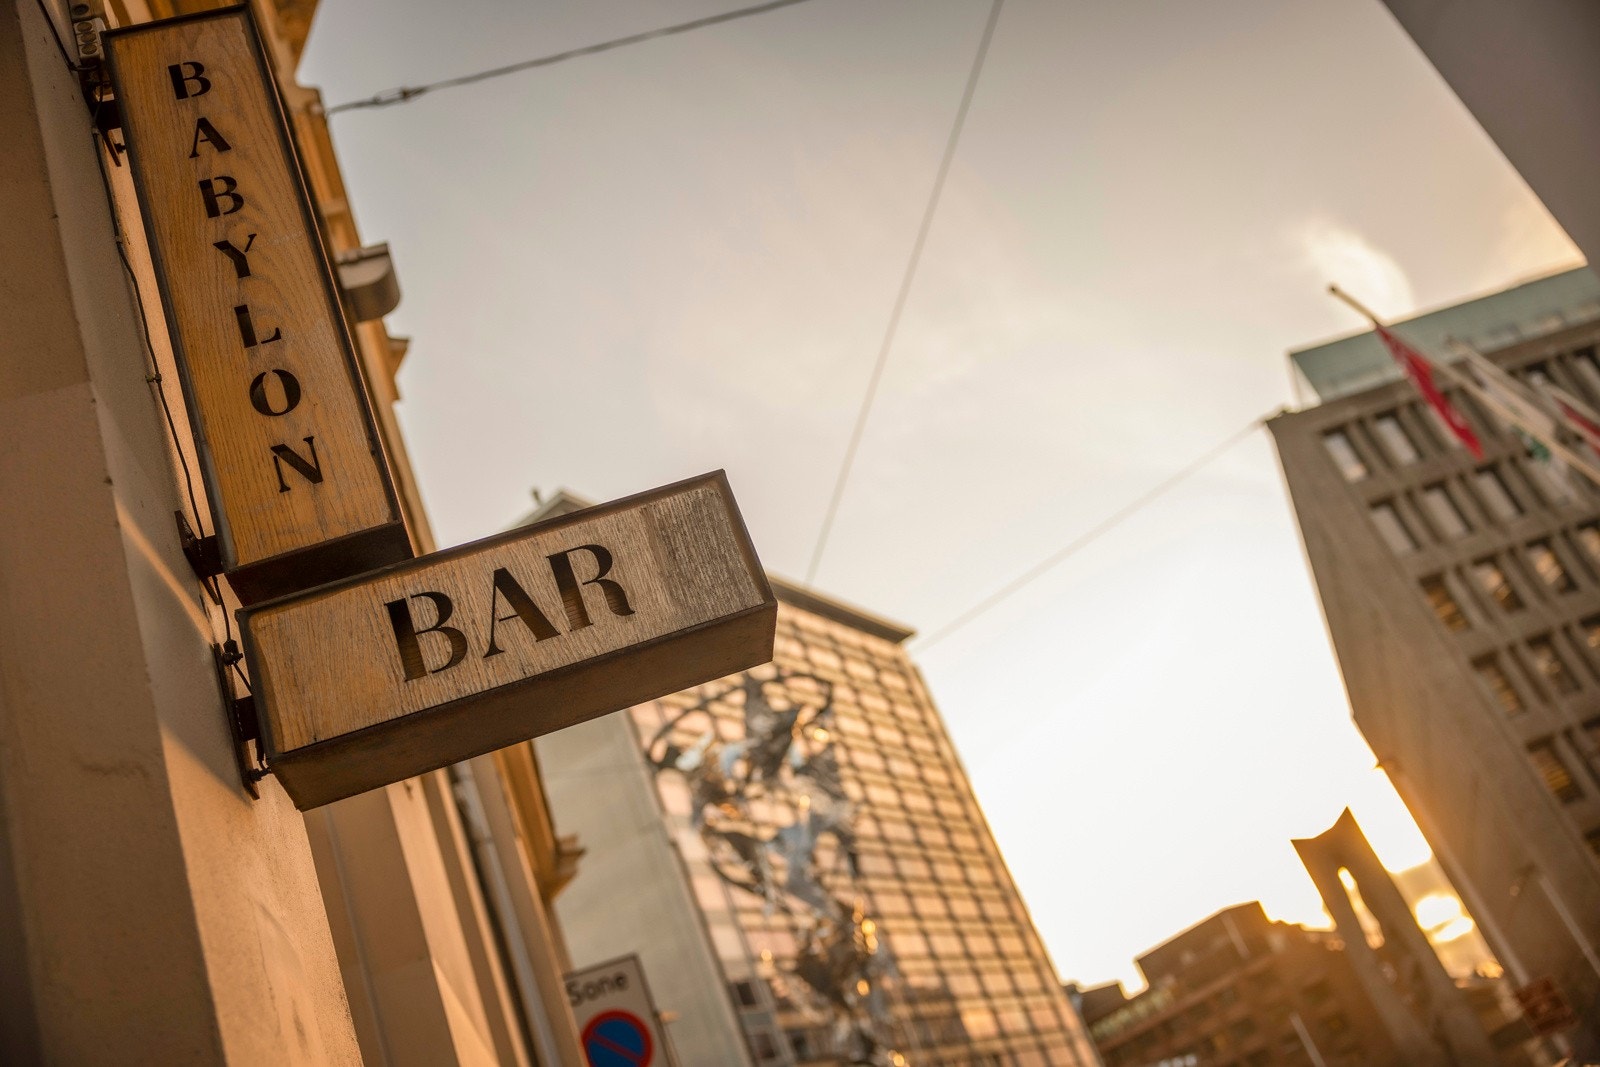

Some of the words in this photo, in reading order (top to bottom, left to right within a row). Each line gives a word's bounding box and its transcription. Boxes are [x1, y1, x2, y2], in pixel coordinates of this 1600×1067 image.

[168, 61, 324, 494] BABYLON
[384, 544, 635, 682] BAR
[566, 972, 630, 1007] Sone
